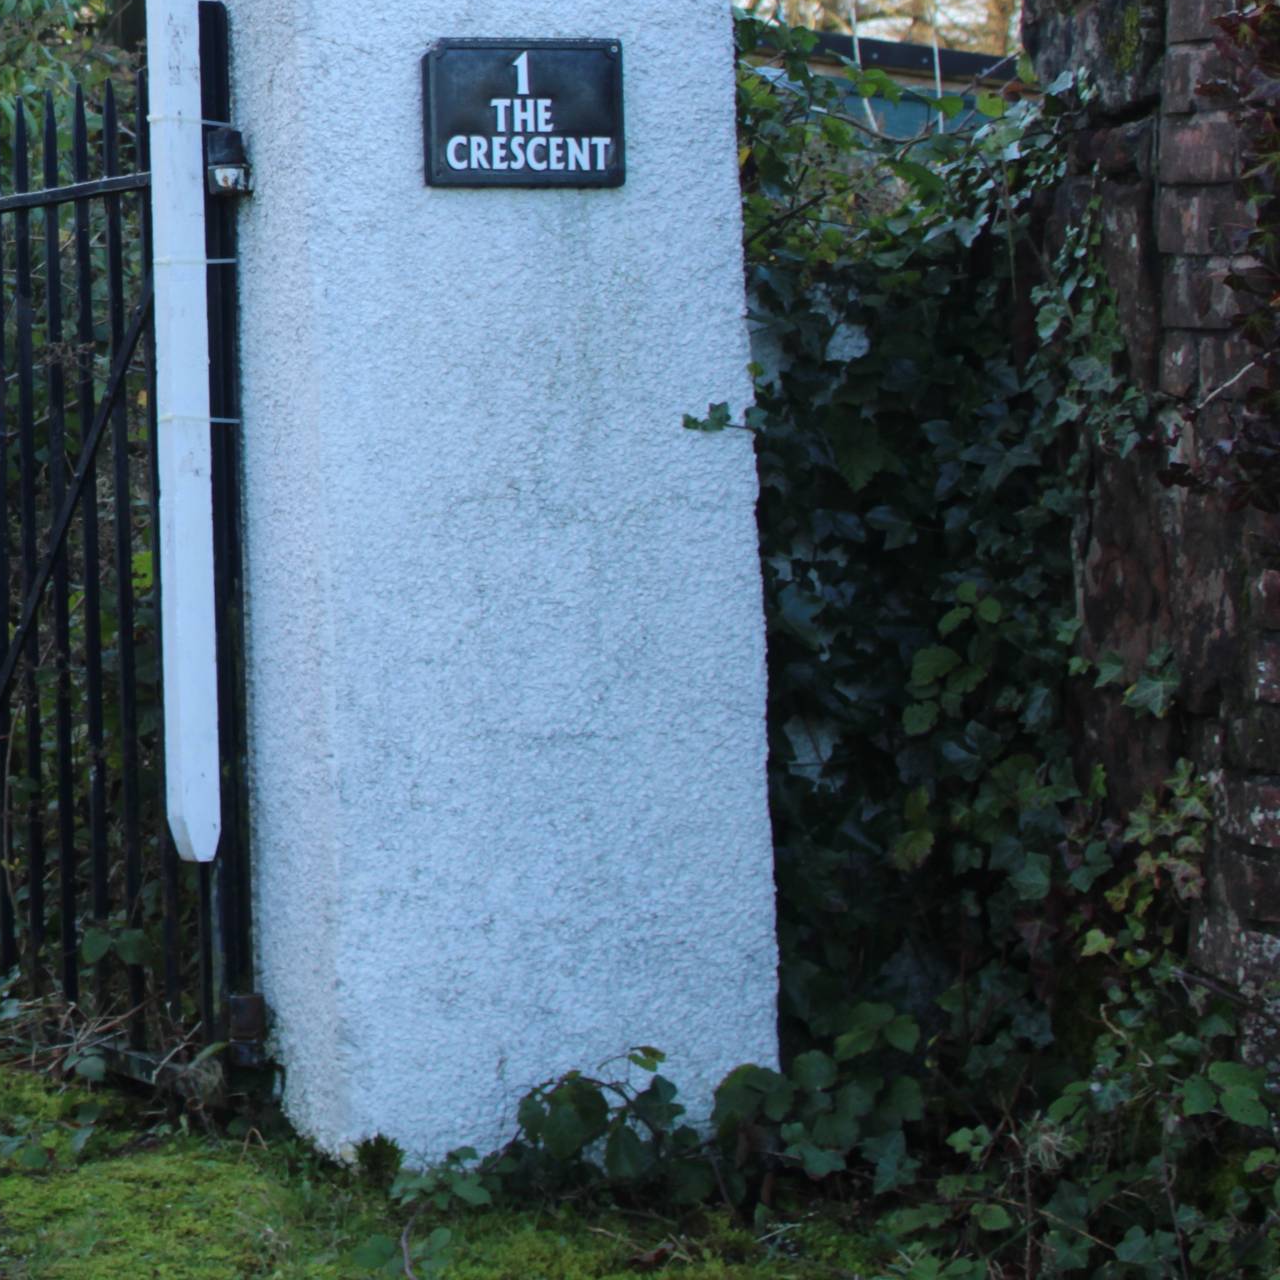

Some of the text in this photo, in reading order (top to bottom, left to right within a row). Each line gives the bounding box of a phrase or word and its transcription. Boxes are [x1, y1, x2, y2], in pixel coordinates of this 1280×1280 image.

[511, 50, 530, 95] 1
[490, 98, 554, 132] THE
[446, 135, 611, 171] CRESCENT
